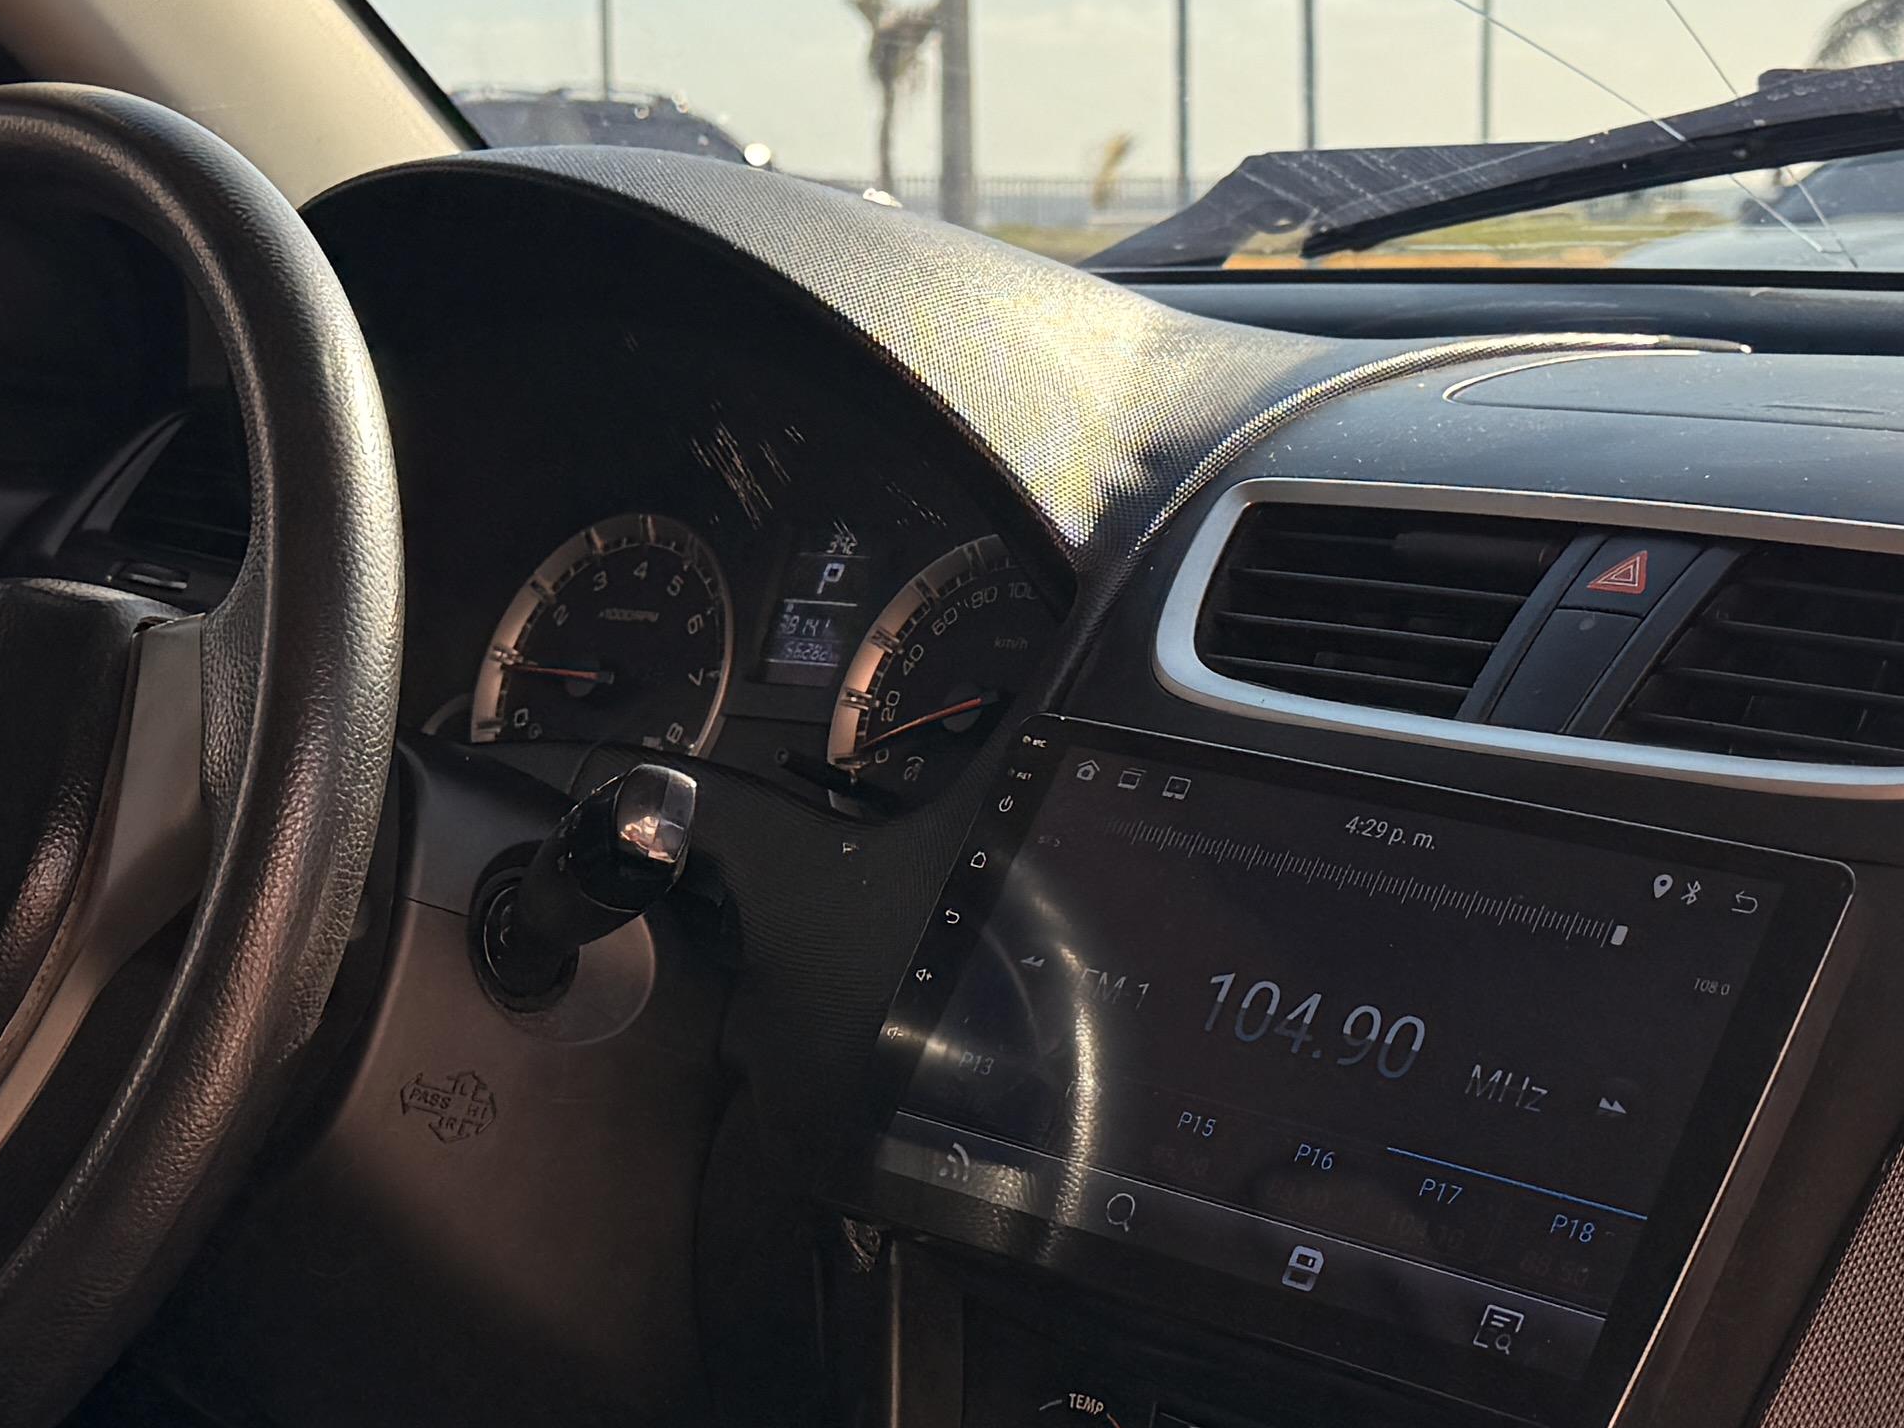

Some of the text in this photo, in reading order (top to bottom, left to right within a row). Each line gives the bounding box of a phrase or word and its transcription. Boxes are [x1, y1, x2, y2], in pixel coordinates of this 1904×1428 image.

[593, 571, 607, 592] 3
[633, 561, 648, 580] 4
[816, 563, 846, 595] P
[667, 575, 684, 596] 5
[971, 585, 999, 610] 80
[553, 605, 569, 627] 2
[687, 614, 704, 634] 6
[931, 606, 959, 637] 60
[902, 643, 925, 677] 40
[881, 690, 901, 723] 20
[1344, 815, 1389, 839] 4:29
[1203, 971, 1426, 1079] 104.90
[408, 1086, 453, 1110] PASS
[1463, 1063, 1550, 1113] MHz
[1176, 1109, 1218, 1139] P15
[1292, 1141, 1336, 1171] P16
[1417, 1176, 1465, 1205] P17
[1548, 1212, 1597, 1244] P18
[1067, 1392, 1105, 1416] TEMP
